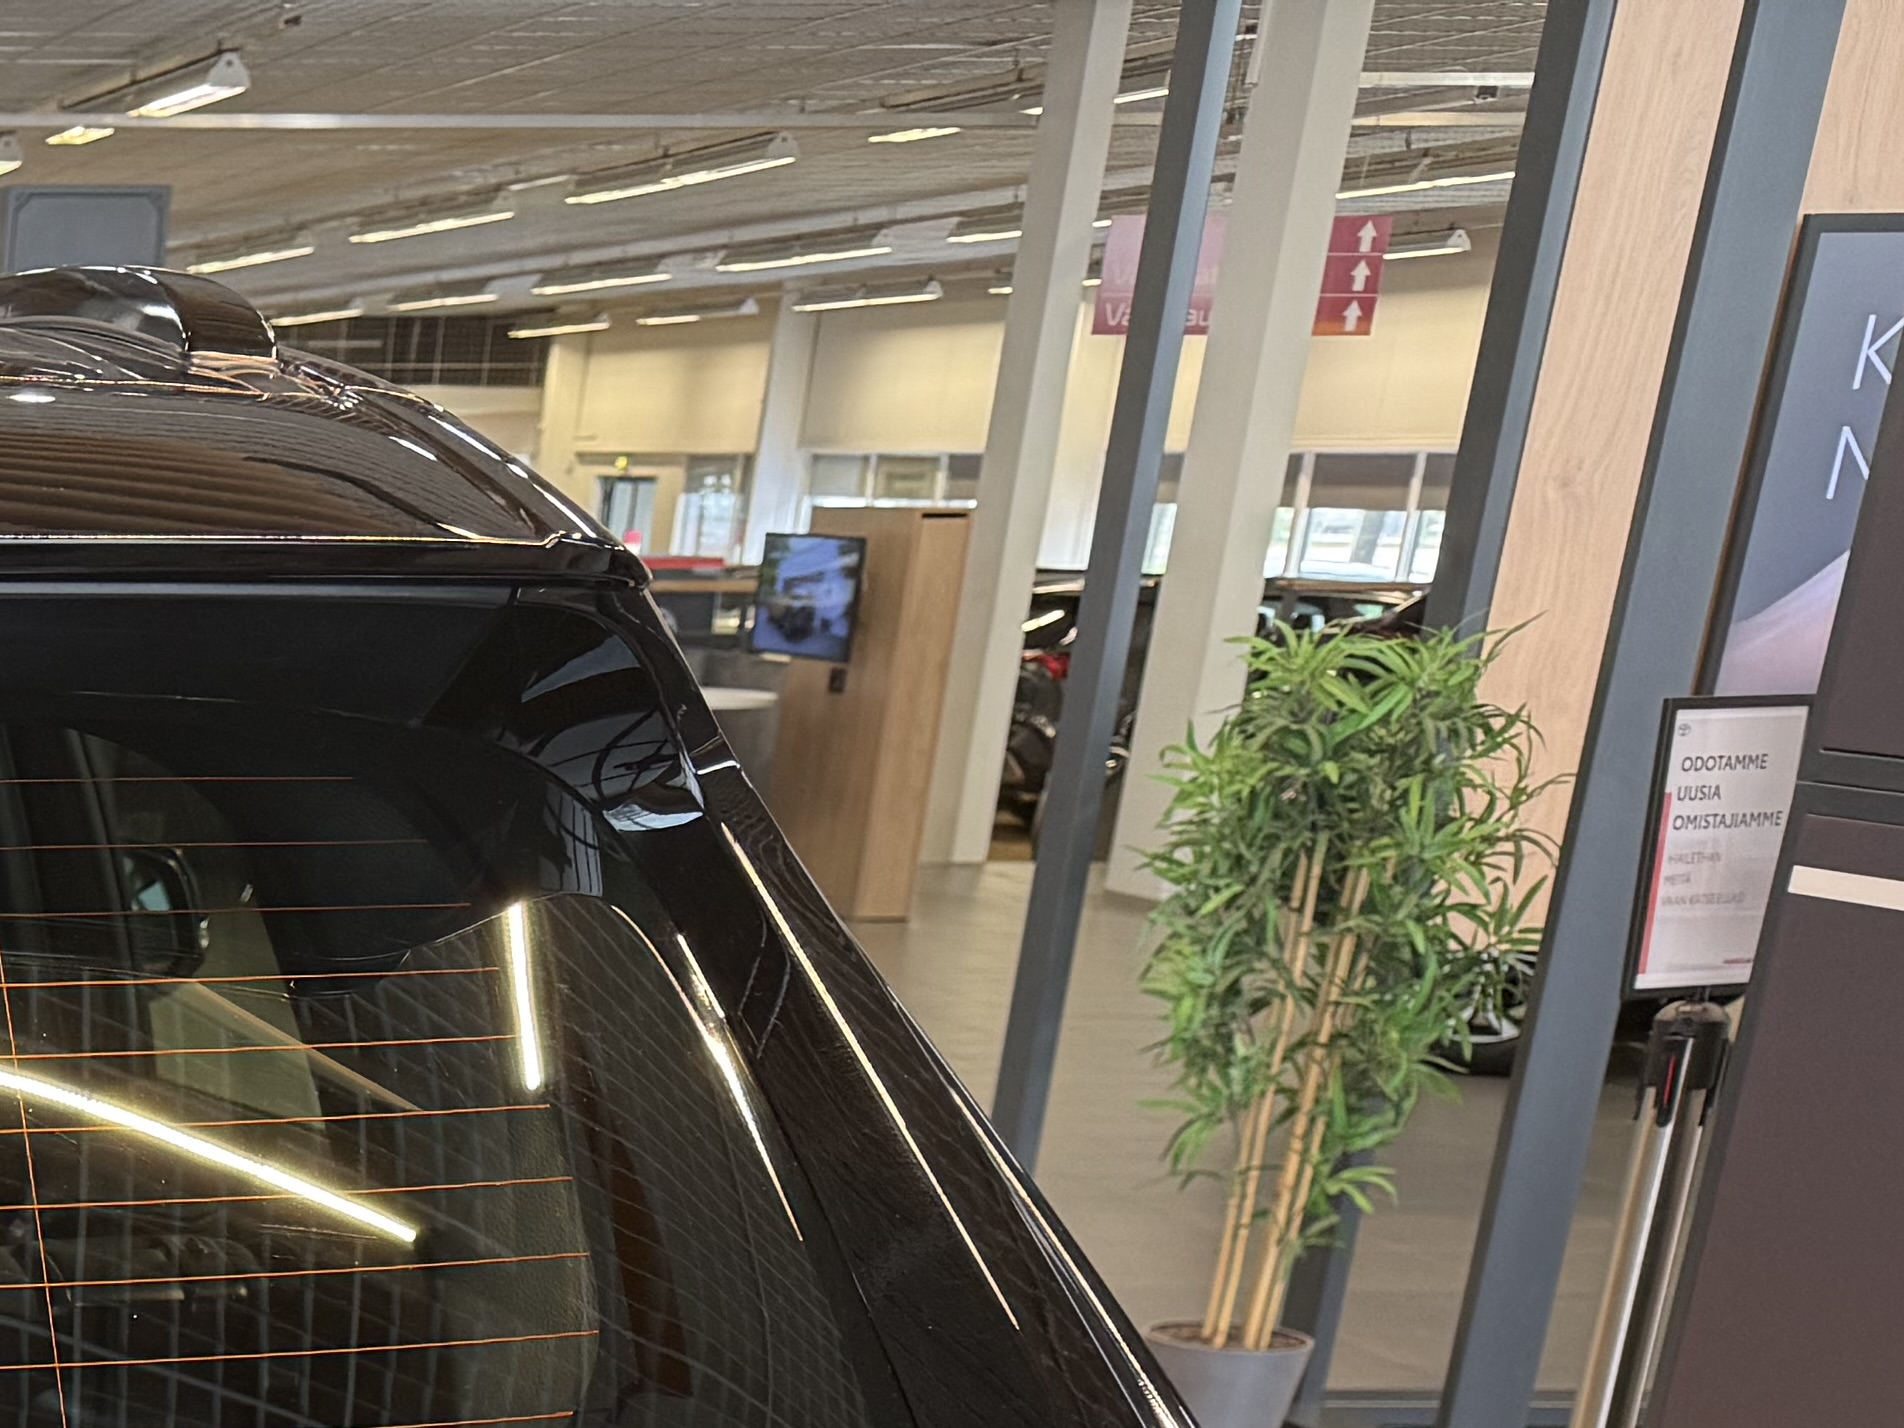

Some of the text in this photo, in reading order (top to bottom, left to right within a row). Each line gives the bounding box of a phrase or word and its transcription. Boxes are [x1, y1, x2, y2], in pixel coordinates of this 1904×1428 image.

[1681, 753, 1769, 772] ODOTAMME
[1676, 784, 1722, 801] UUSIA
[1672, 811, 1784, 831] OMISTAJIAMME
